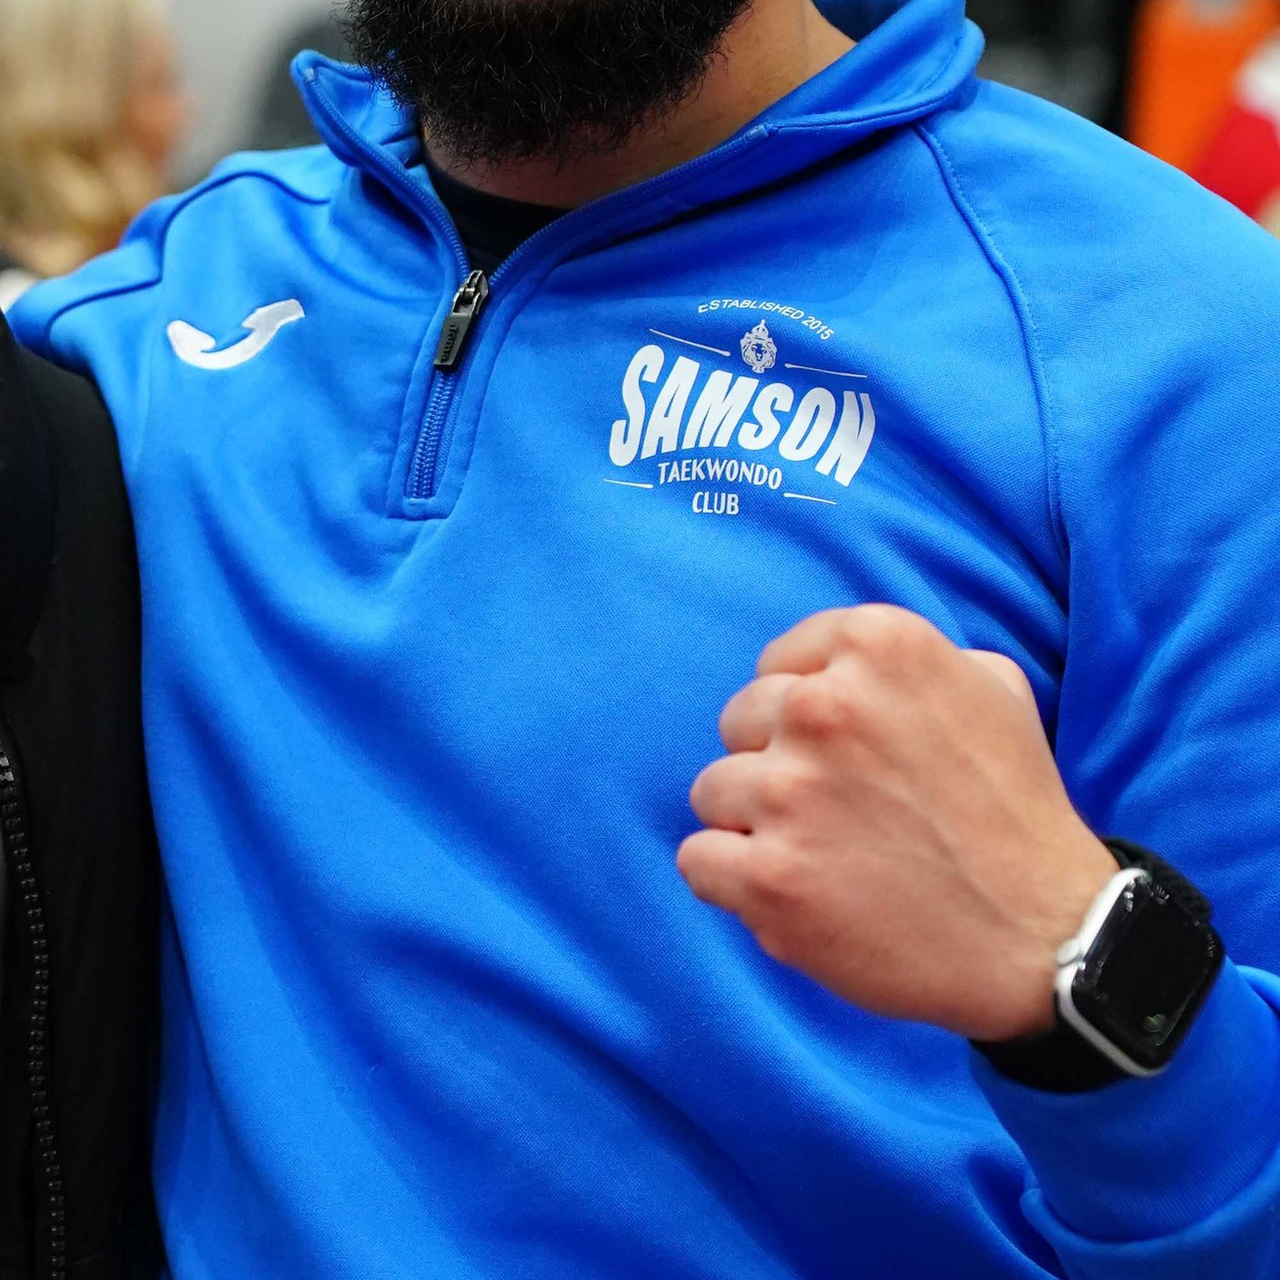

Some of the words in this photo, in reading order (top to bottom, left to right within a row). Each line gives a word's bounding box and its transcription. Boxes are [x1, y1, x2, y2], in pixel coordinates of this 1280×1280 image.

[698, 299, 804, 321] ESTABLISHED
[802, 316, 834, 341] 2015
[608, 344, 876, 487] SAMSON
[658, 459, 783, 489] TAEKWONDO
[692, 491, 739, 515] CLUB
